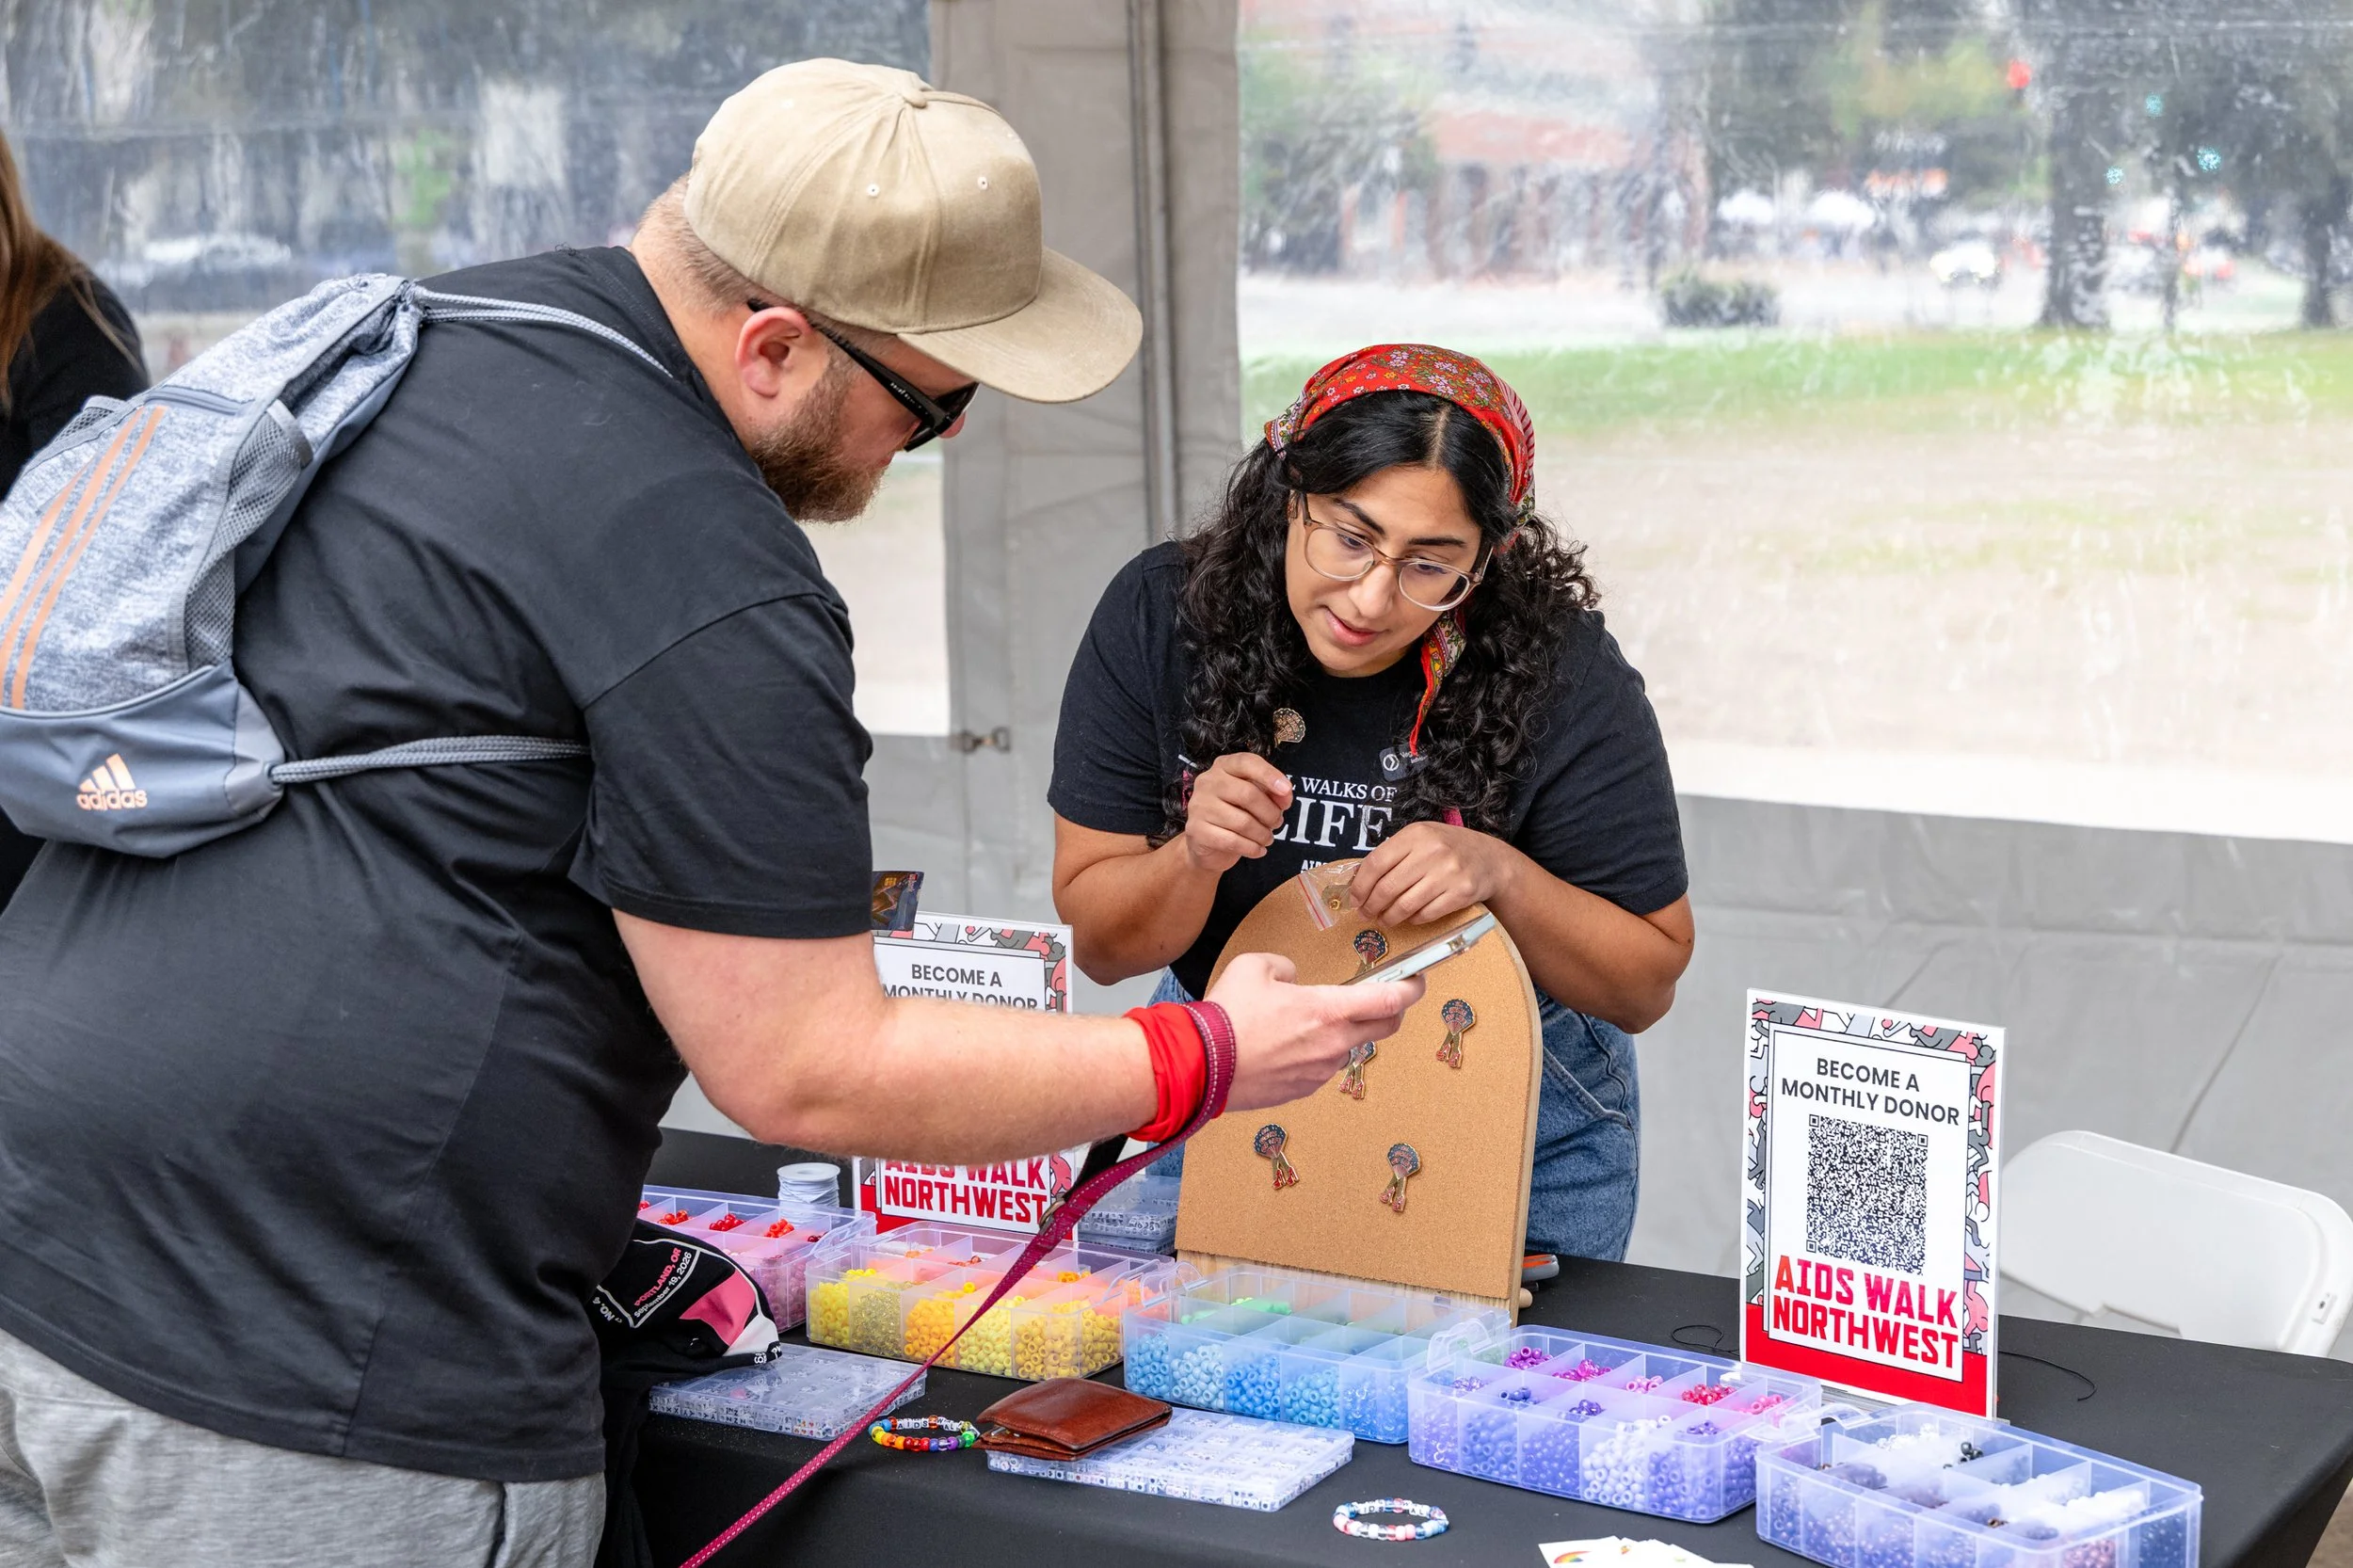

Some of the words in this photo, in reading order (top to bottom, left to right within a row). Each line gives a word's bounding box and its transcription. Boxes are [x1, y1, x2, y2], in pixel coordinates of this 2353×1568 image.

[76, 789, 148, 811] adidas
[1301, 776, 1368, 800] WALKS
[1370, 785, 1398, 803] OF
[911, 964, 985, 985] BECOME
[989, 971, 1002, 988] A
[972, 992, 1038, 1010] DONOR
[1817, 1057, 1900, 1089] BECOME
[1905, 1073, 1920, 1093] A
[1782, 1078, 1880, 1111] MONTHLY
[1884, 1096, 1960, 1127] DONOR
[885, 1176, 1048, 1224] NORTHWEST
[634, 1264, 676, 1306] PORTLAND,
[670, 1247, 681, 1263] OR
[1774, 1255, 1854, 1305] AIDS
[1865, 1272, 1958, 1329] WALK
[1773, 1294, 1959, 1368] NORTHWEST
[898, 1419, 928, 1430] AIDS
